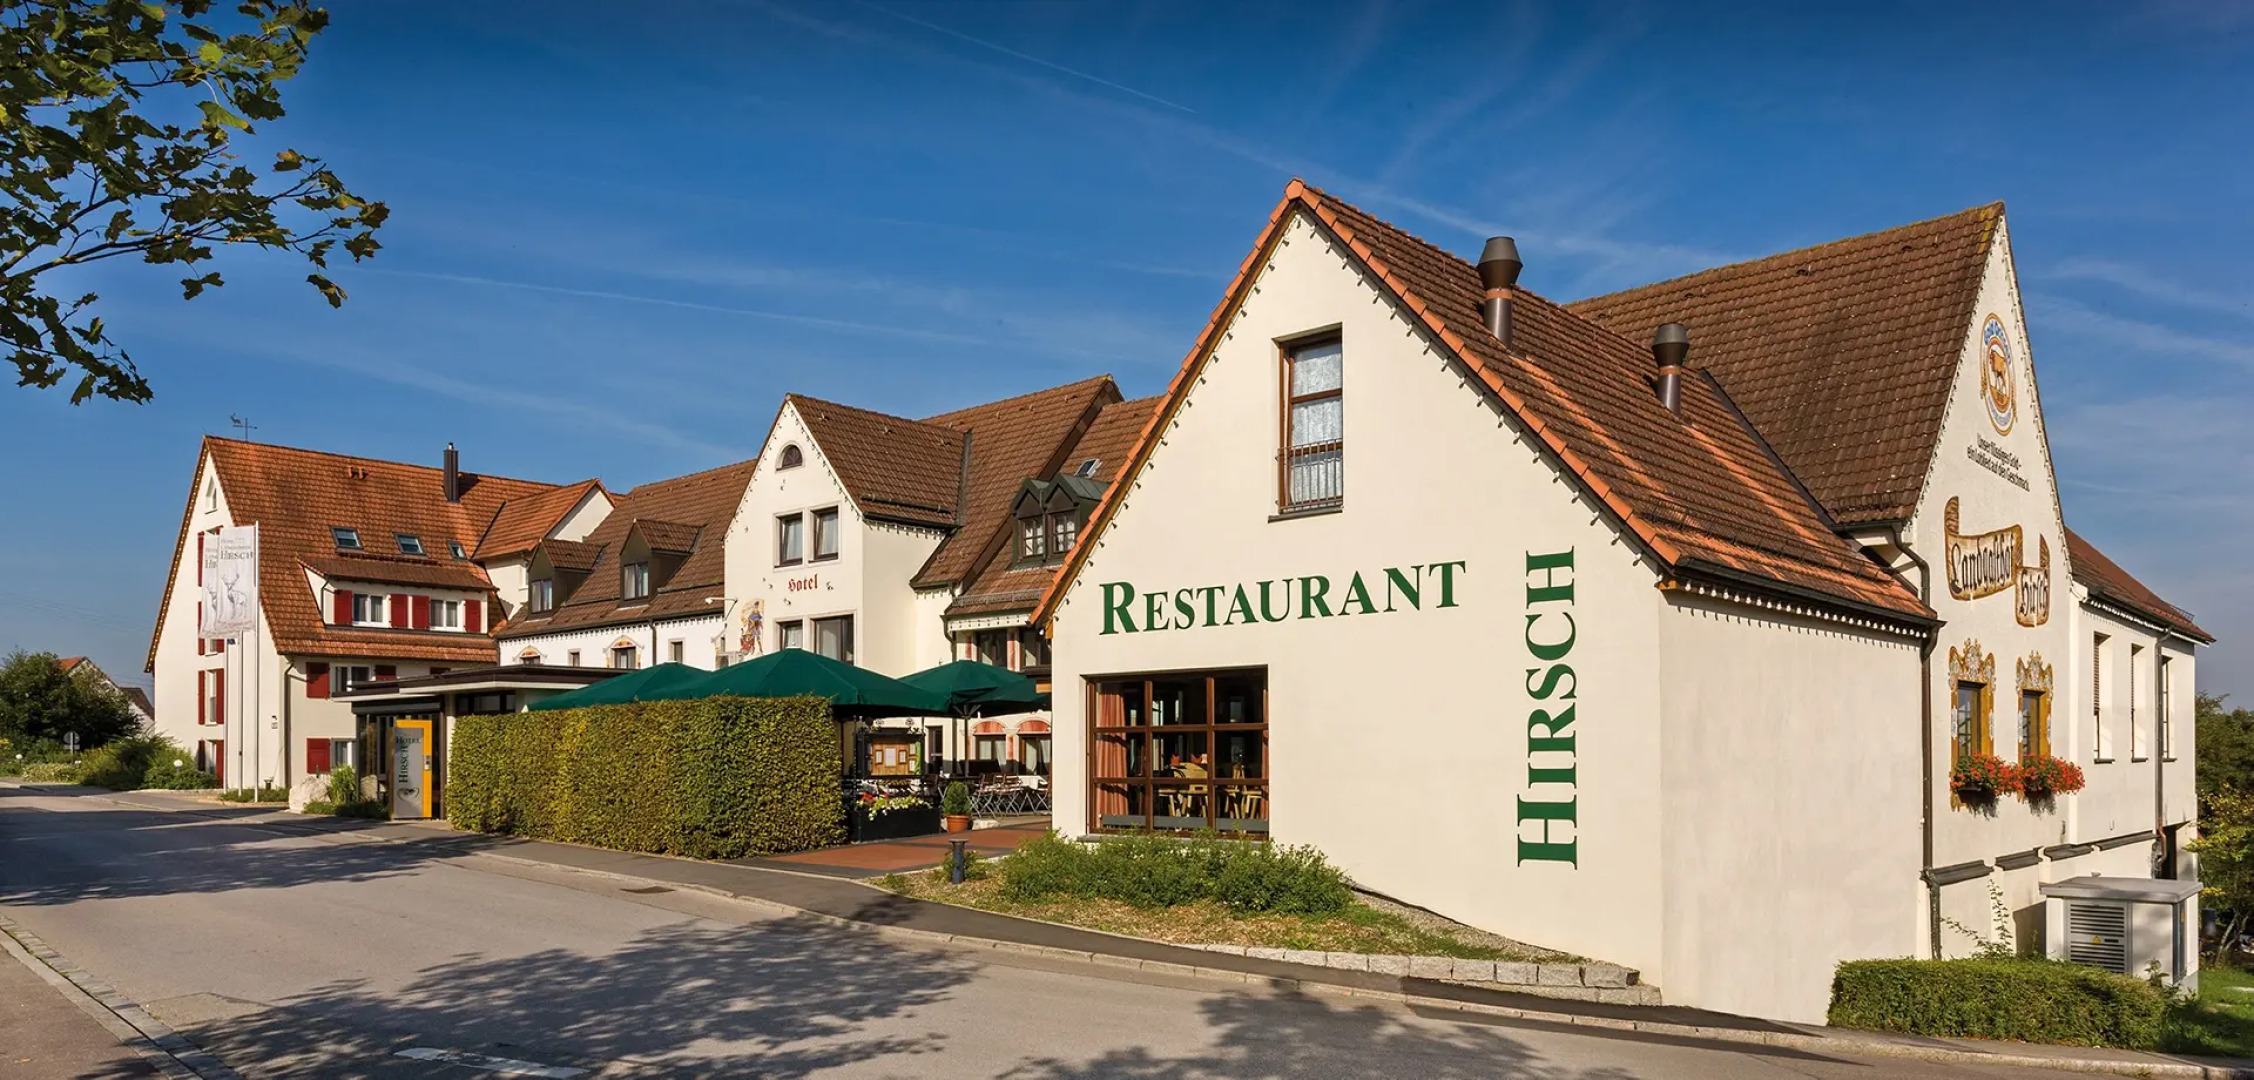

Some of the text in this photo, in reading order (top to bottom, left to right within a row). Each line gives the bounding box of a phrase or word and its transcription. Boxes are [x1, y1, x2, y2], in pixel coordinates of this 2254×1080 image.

[788, 573, 818, 592] Hotel
[1099, 560, 1467, 636] RESTAURANT
[1517, 545, 1578, 870] HIRSCH
[399, 745, 408, 783] HIRSCH
